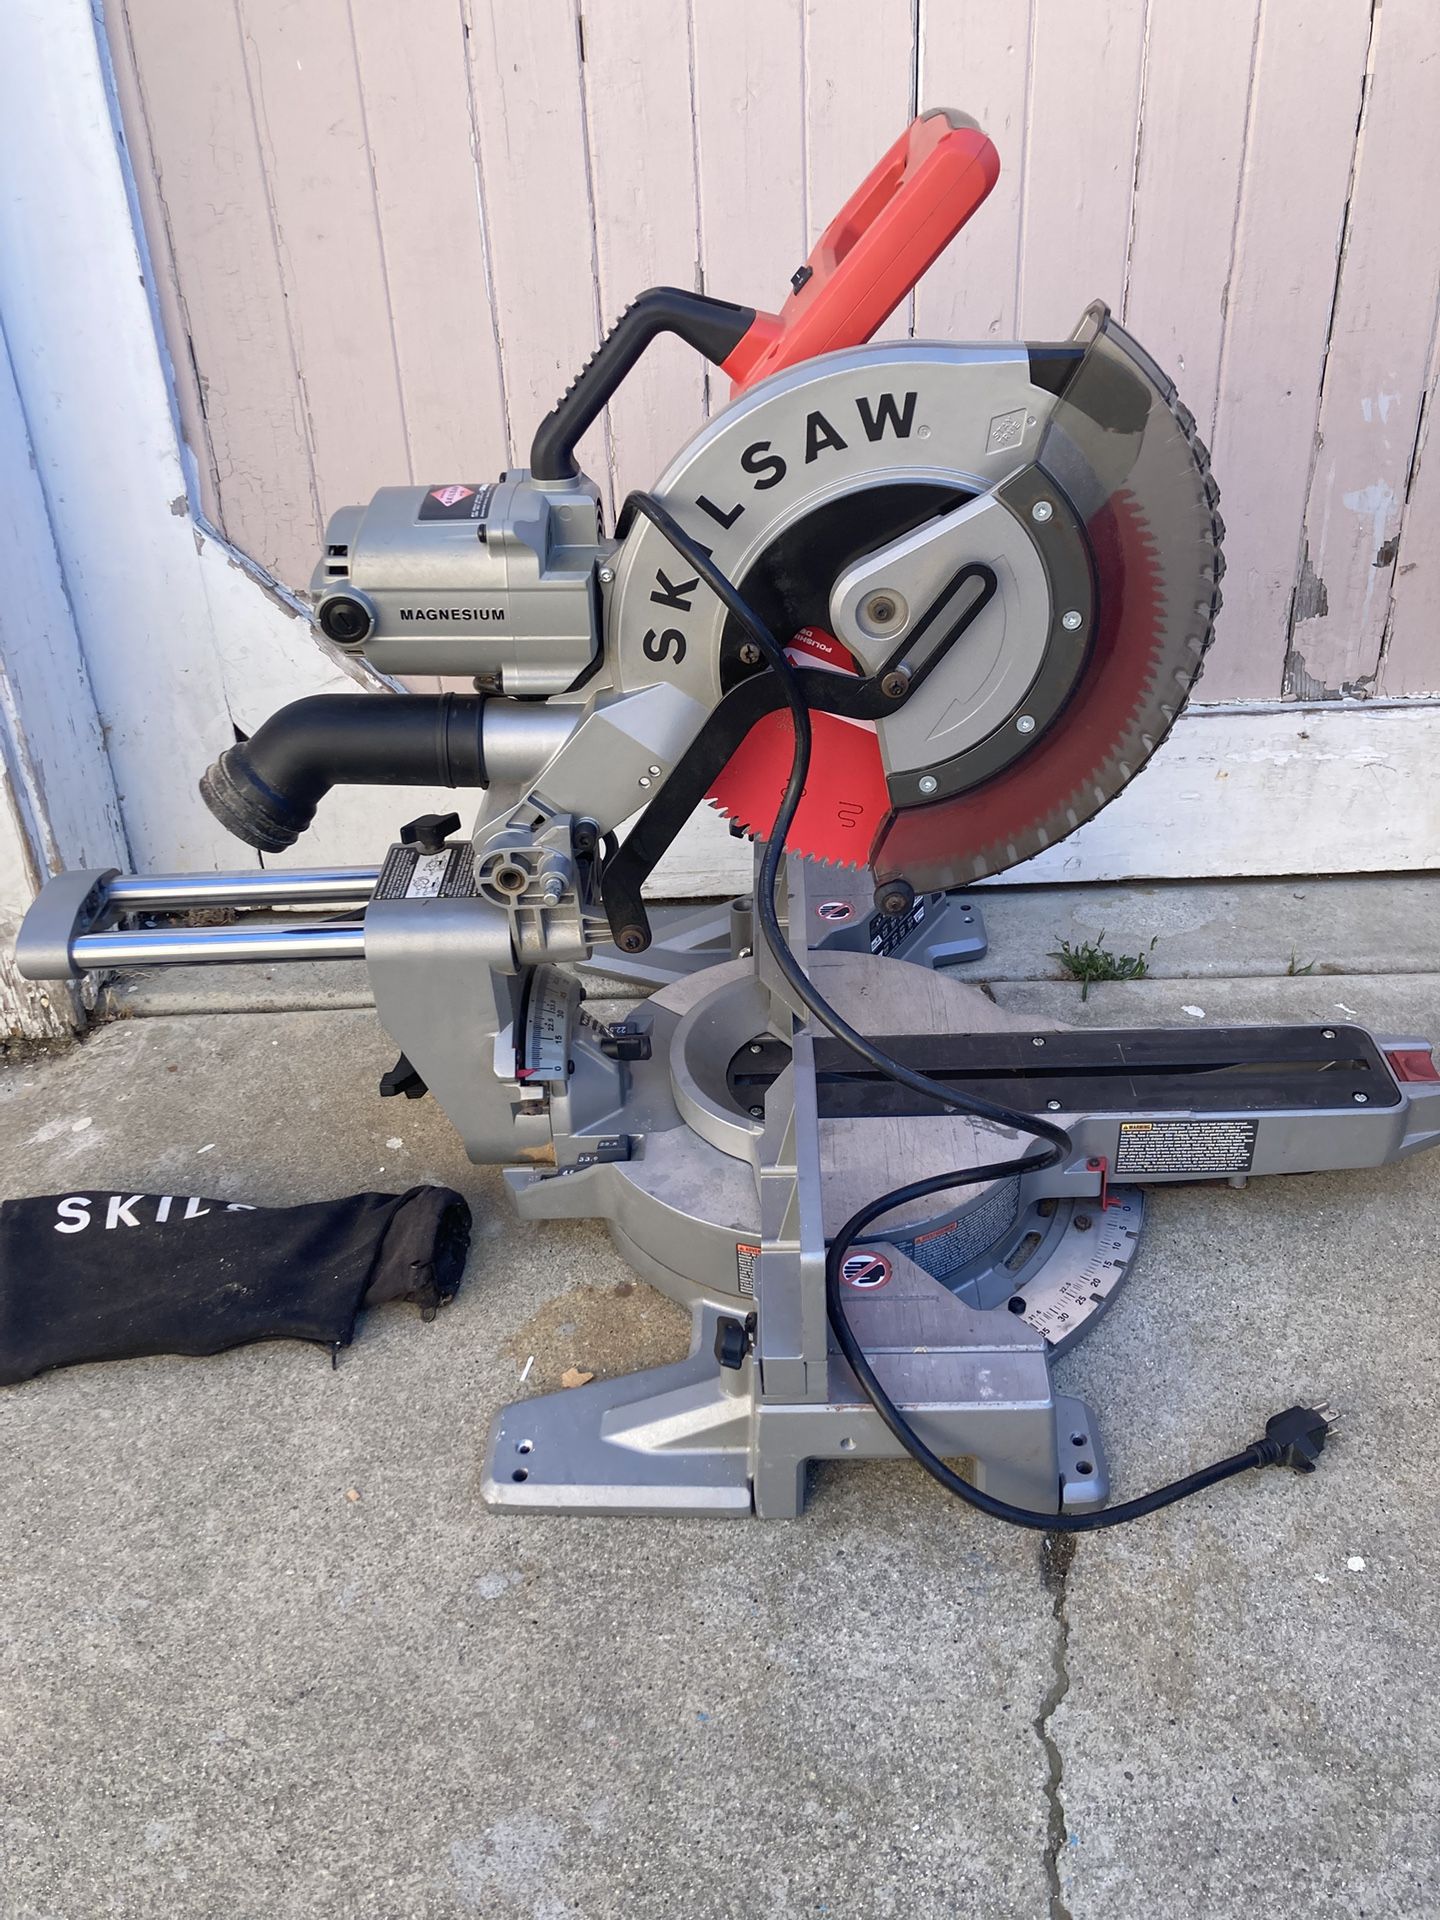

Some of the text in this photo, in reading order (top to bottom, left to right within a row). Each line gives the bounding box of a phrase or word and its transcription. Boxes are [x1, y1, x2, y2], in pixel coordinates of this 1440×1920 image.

[643, 392, 918, 665] SKLSAW
[399, 608, 505, 621] MAGNESIUM
[555, 1035, 562, 1043] 15
[1112, 1241, 1121, 1250] 10
[1102, 1260, 1112, 1269] 15
[1060, 1282, 1072, 1294] 22.5
[1090, 1277, 1101, 1288] 20
[1075, 1295, 1087, 1306] 25
[1057, 1312, 1070, 1323] 30
